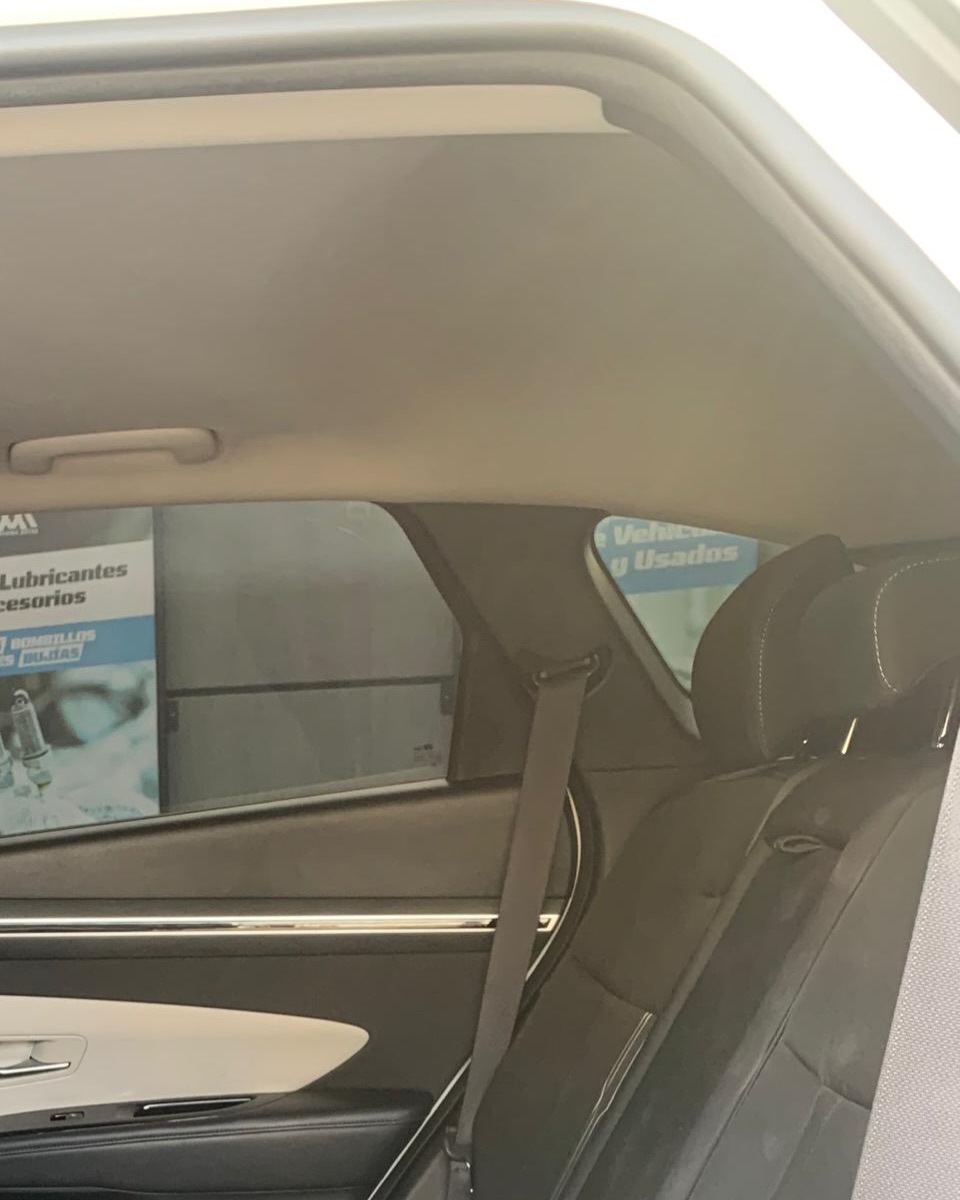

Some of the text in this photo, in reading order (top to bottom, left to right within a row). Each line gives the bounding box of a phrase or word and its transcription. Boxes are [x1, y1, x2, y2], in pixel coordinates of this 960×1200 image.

[610, 543, 738, 578] y Usados
[0, 563, 128, 591] Lubricantes
[11, 629, 96, 649] BOMBILLOS
